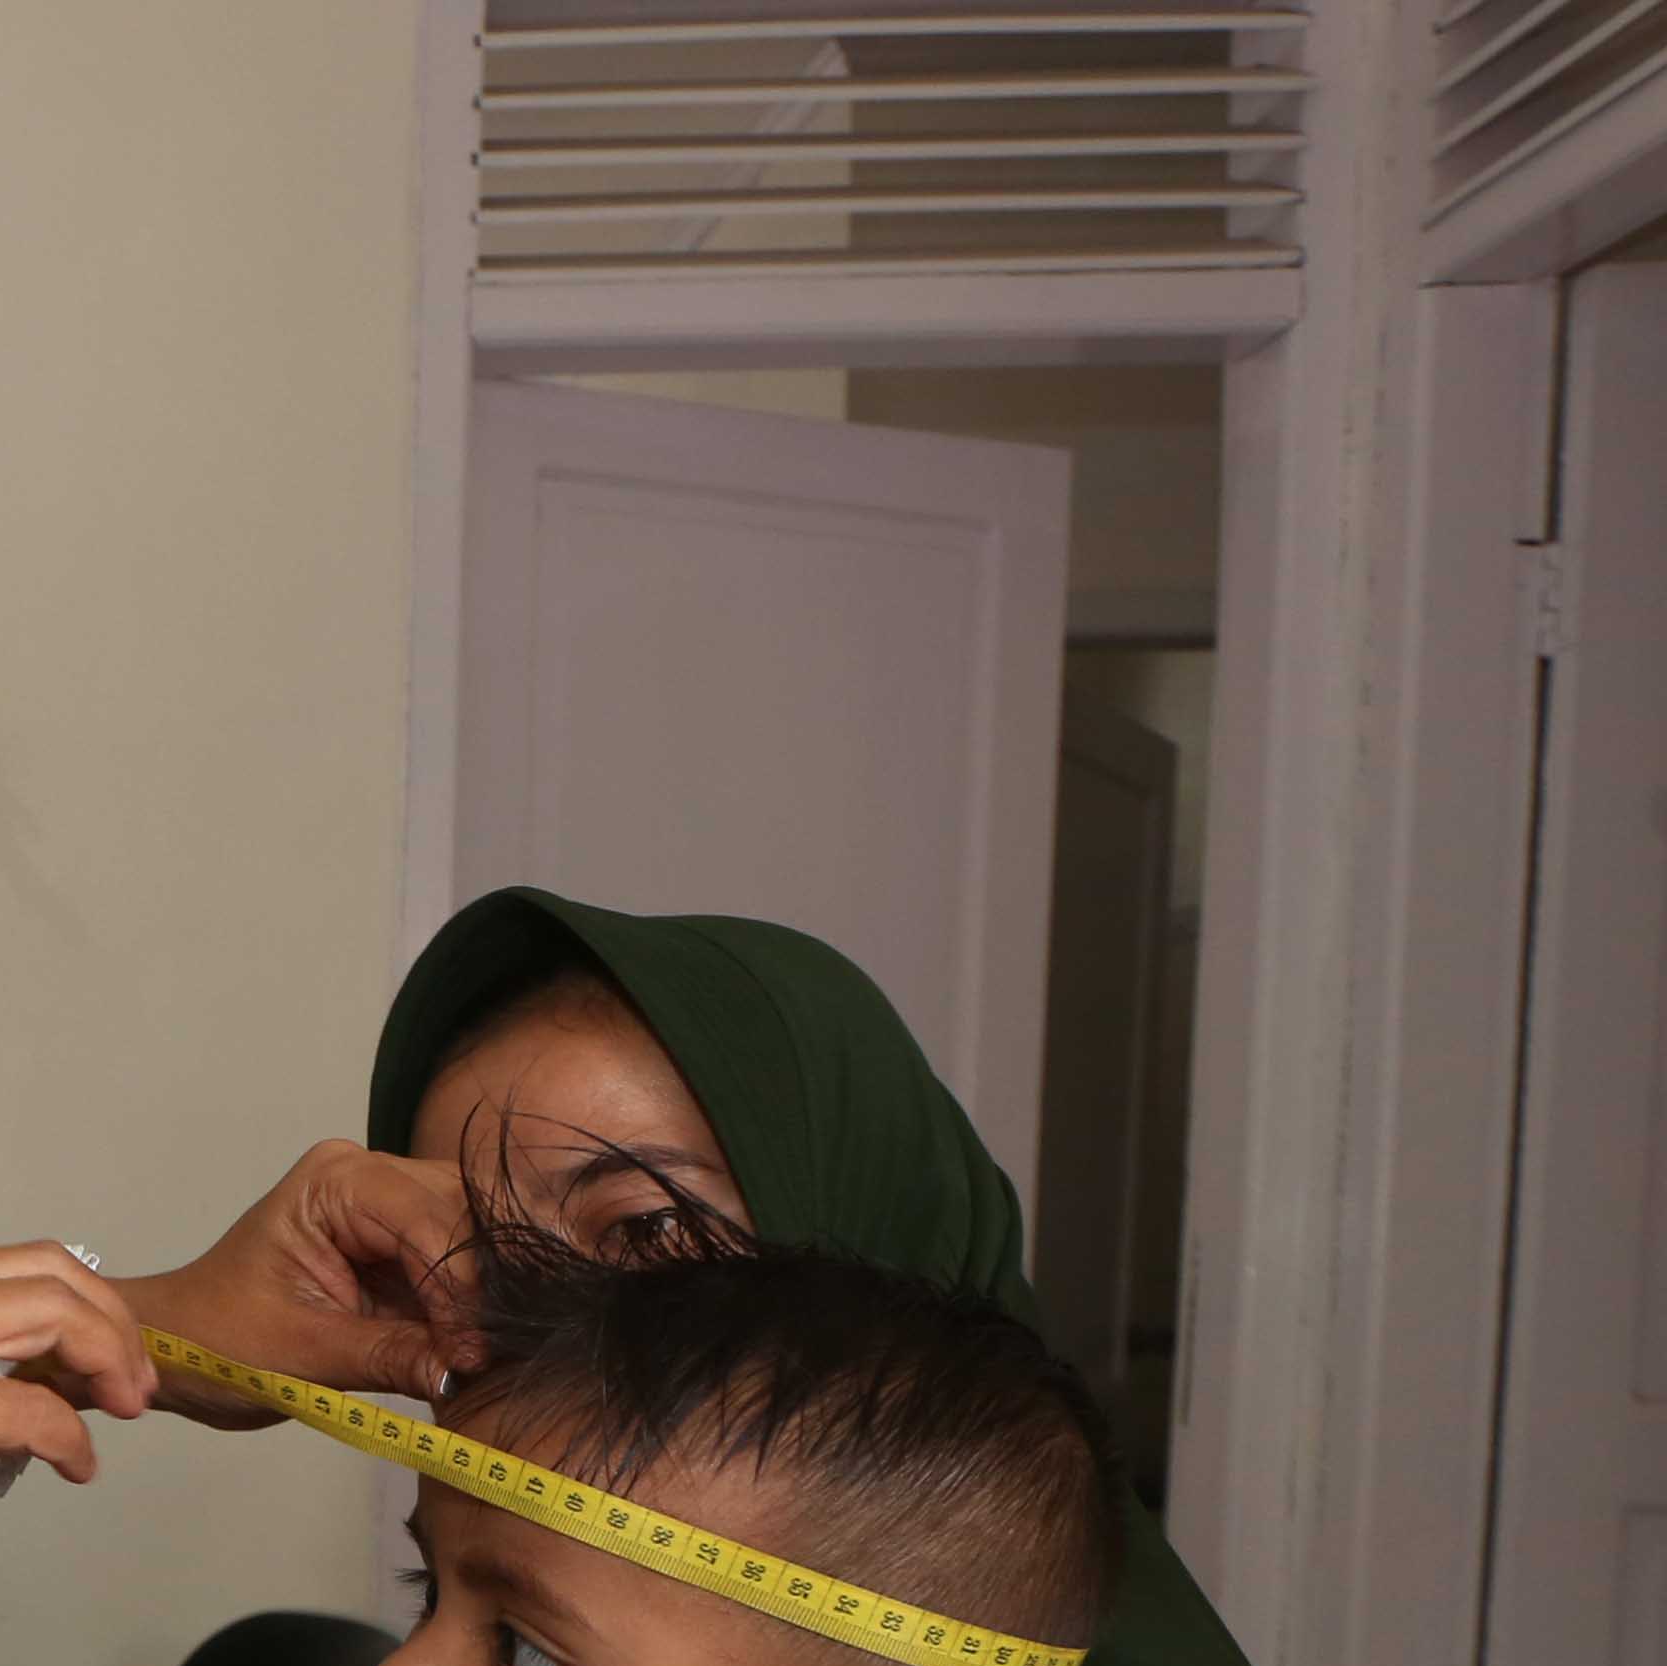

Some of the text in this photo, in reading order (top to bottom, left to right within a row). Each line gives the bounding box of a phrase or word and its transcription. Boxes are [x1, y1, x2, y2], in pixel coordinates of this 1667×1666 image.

[314, 1395, 332, 1416] 47
[347, 1407, 366, 1428] 46
[381, 1420, 402, 1441] 45
[417, 1433, 436, 1454] 44
[453, 1447, 471, 1468] 43
[489, 1461, 508, 1482] 42
[526, 1476, 546, 1497] 41
[564, 1491, 586, 1512] 40
[606, 1508, 630, 1529] 39
[650, 1525, 676, 1548] 38
[696, 1542, 720, 1565] 37
[741, 1560, 766, 1583] 36
[788, 1577, 813, 1600] 35
[833, 1594, 859, 1616] 34
[881, 1610, 905, 1632] 33
[922, 1624, 947, 1646] 32
[961, 1636, 982, 1656] 31
